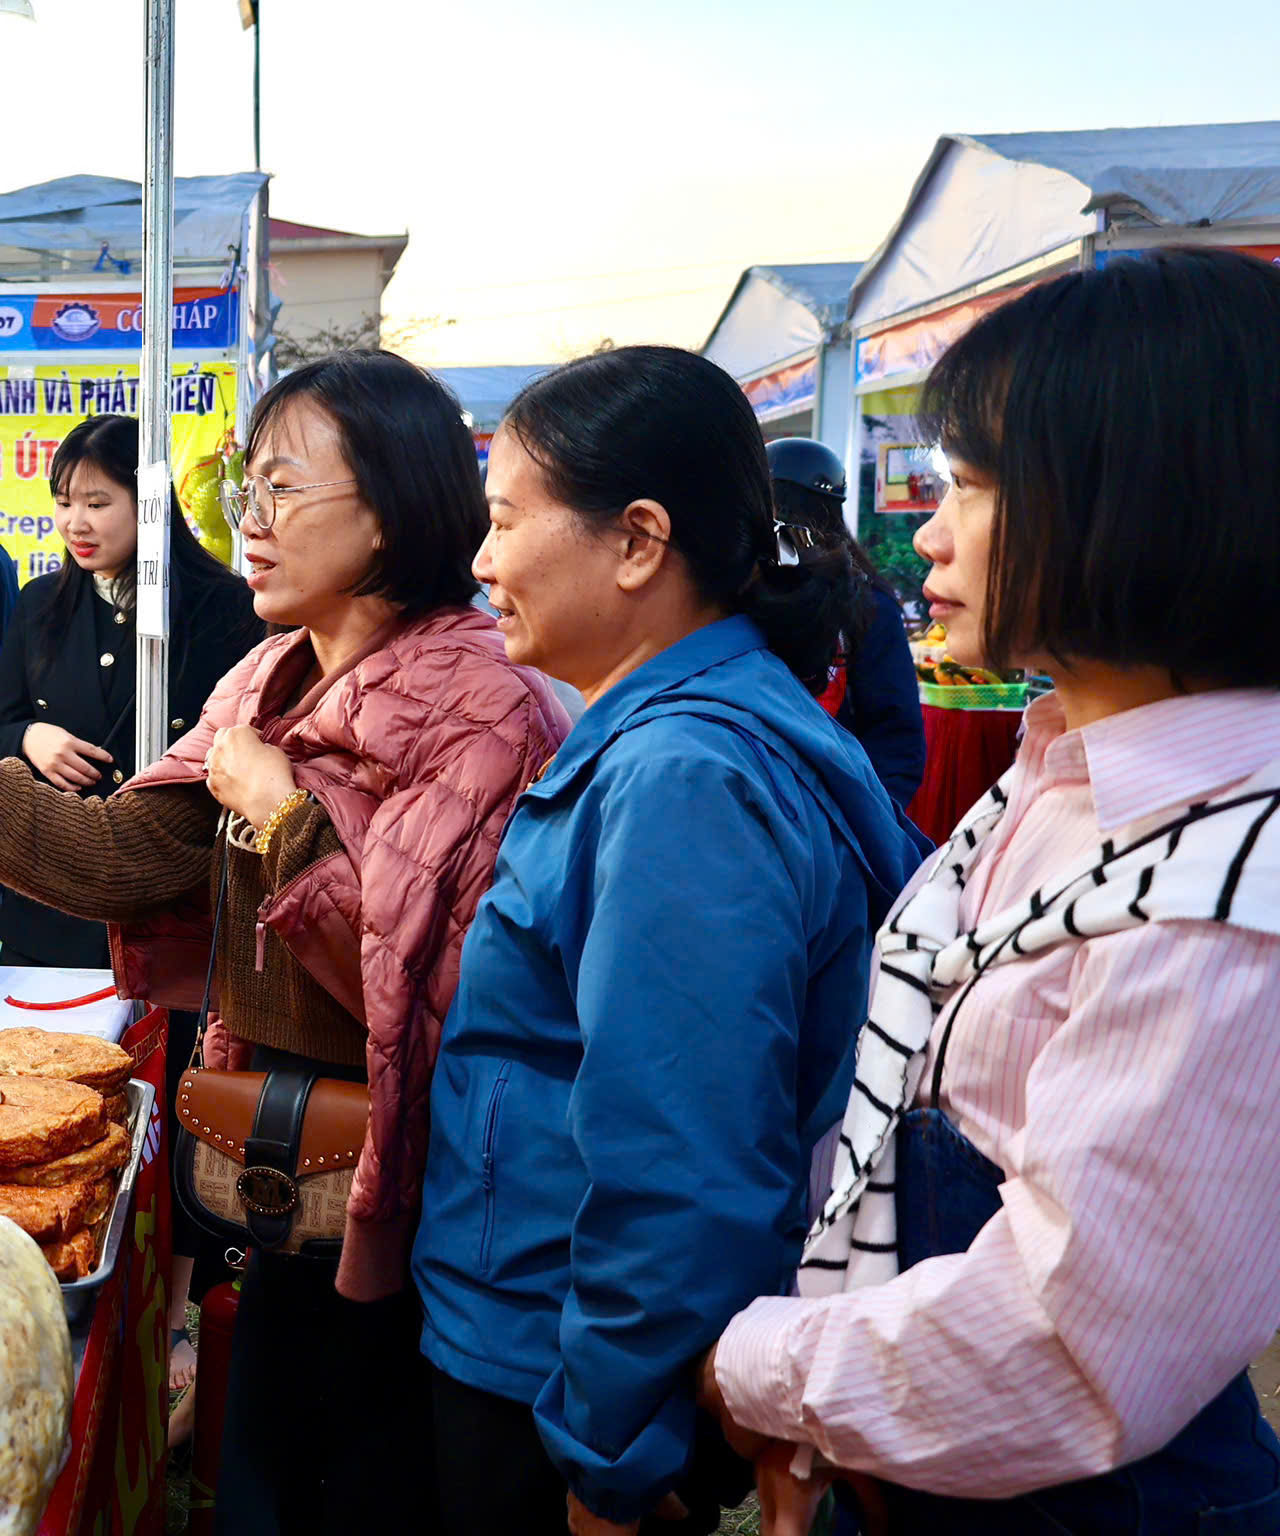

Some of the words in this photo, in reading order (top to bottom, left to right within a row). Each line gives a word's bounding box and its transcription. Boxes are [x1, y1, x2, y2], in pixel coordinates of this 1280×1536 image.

[172, 299, 217, 329] HÁP
[43, 371, 73, 414] VÀ
[80, 370, 139, 413] PHÁT
